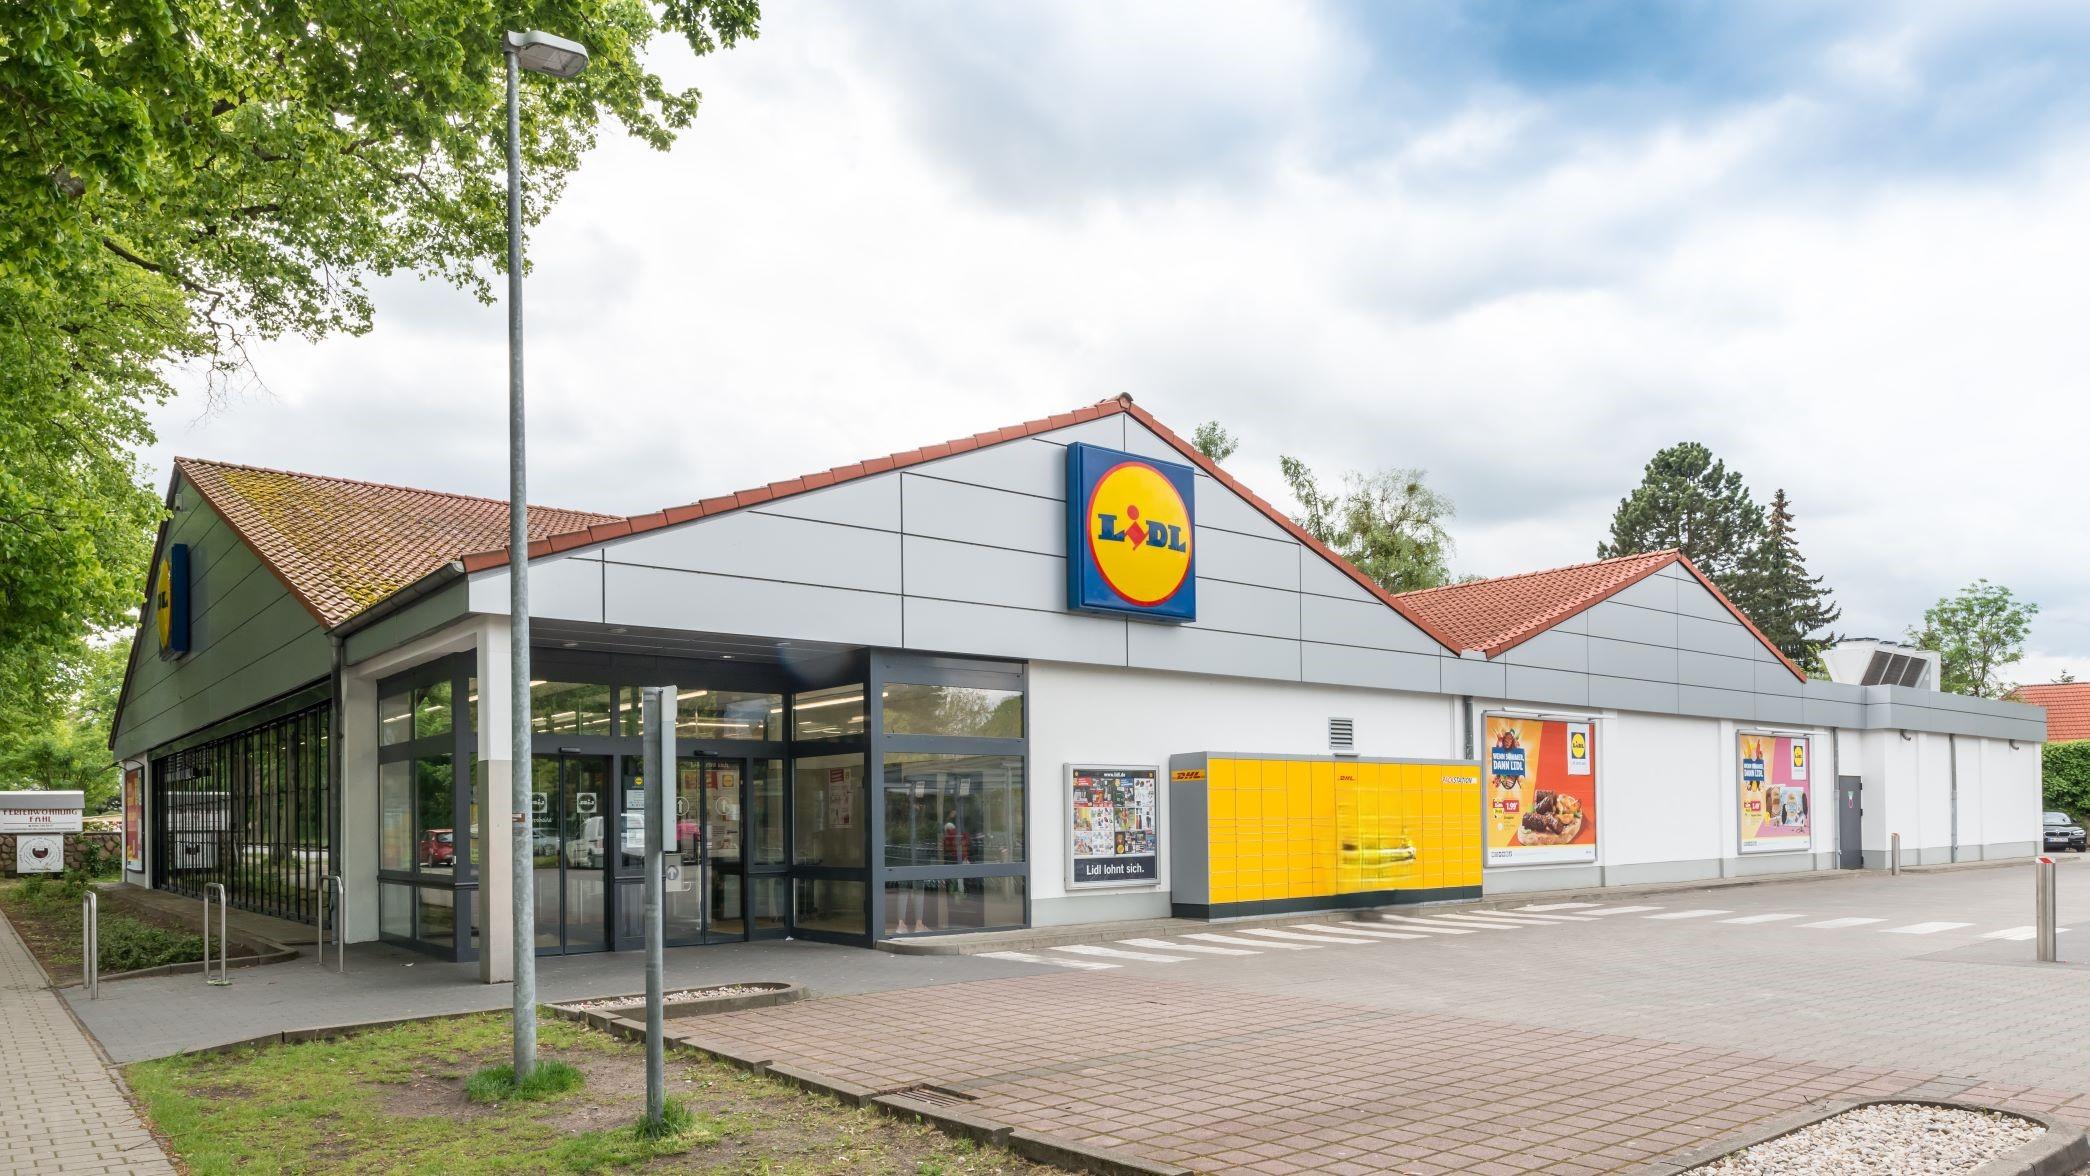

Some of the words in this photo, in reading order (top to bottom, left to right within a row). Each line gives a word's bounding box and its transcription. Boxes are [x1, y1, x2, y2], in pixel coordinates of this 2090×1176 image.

[1098, 505, 1186, 553] LIDL
[1493, 760, 1510, 770] DANN
[1511, 761, 1524, 771] LIDL
[1177, 771, 1200, 779] DHL
[1086, 864, 1102, 875] Lidl
[1104, 864, 1125, 874] lohnt
[1126, 862, 1145, 874] sich.
